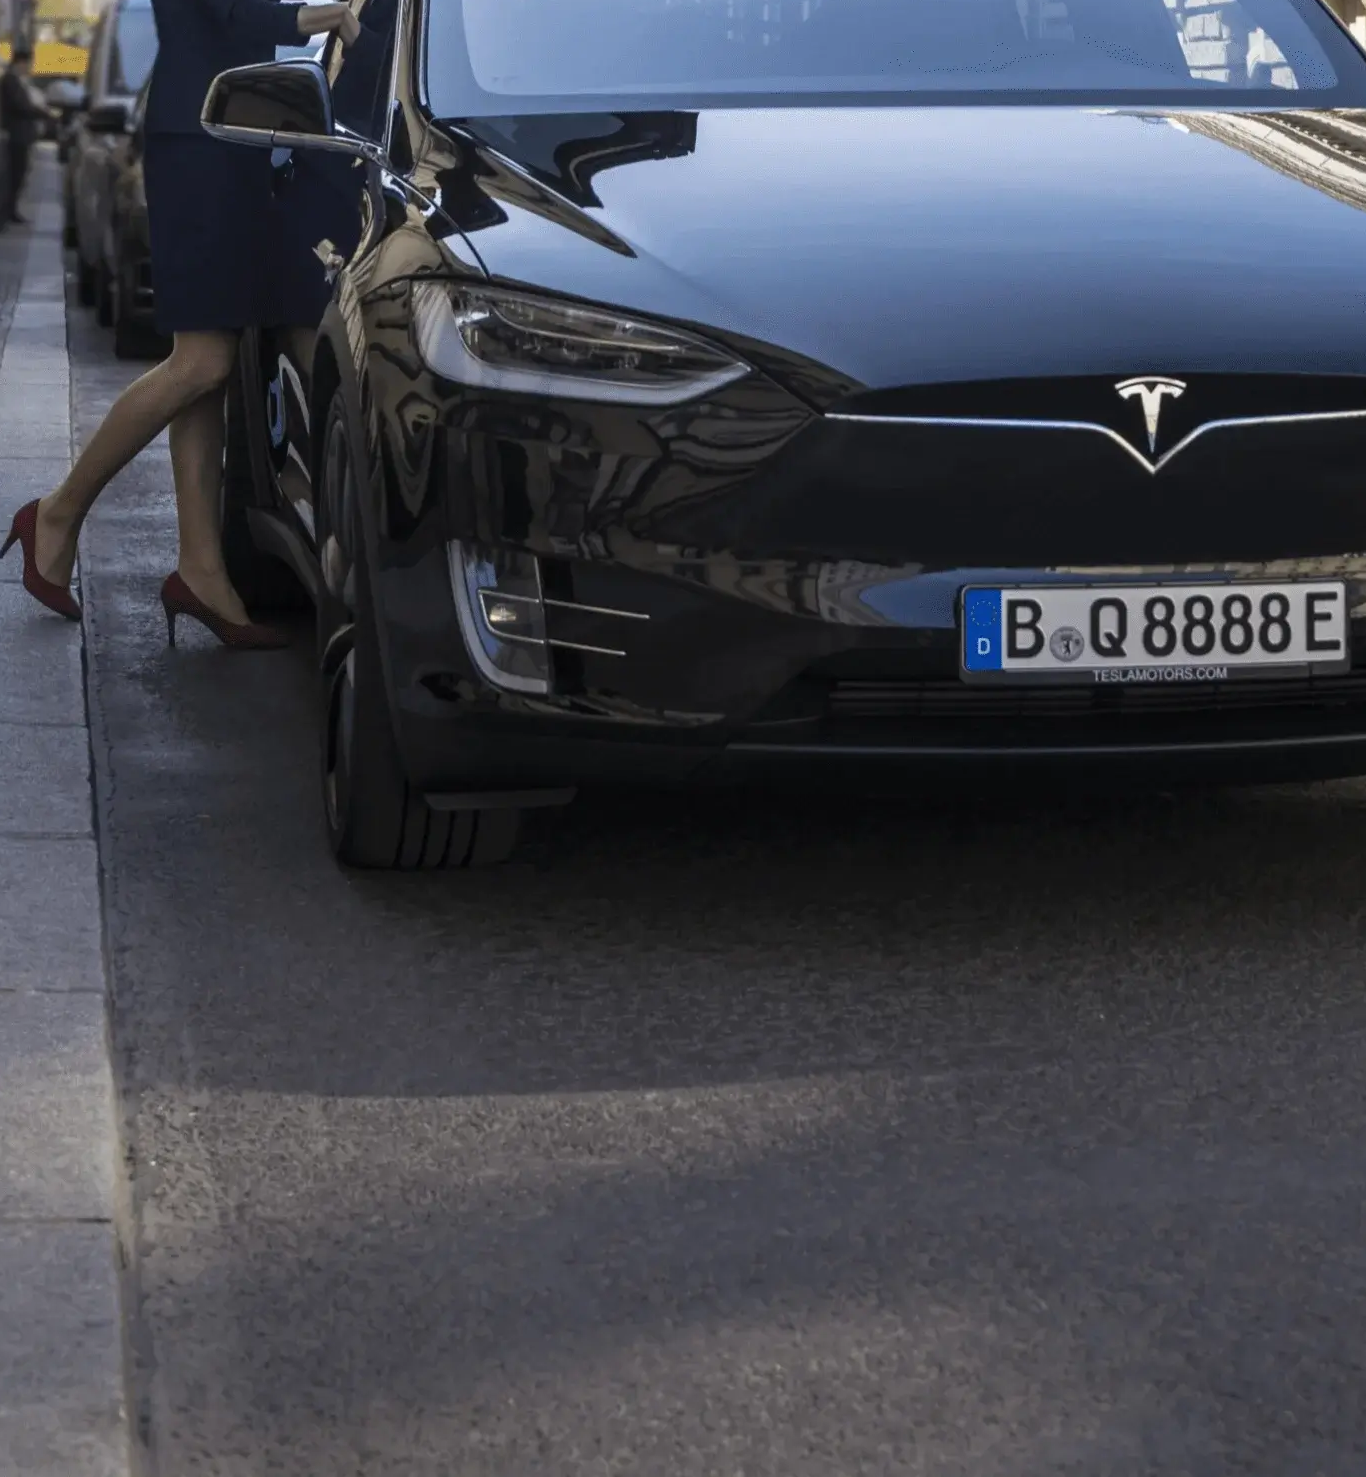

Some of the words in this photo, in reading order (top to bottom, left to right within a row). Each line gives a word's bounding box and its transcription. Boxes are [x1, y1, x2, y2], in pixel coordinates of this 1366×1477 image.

[1006, 599, 1045, 659] B
[977, 637, 991, 655] D
[1092, 666, 1228, 683] TESLAMOTORS.COM
